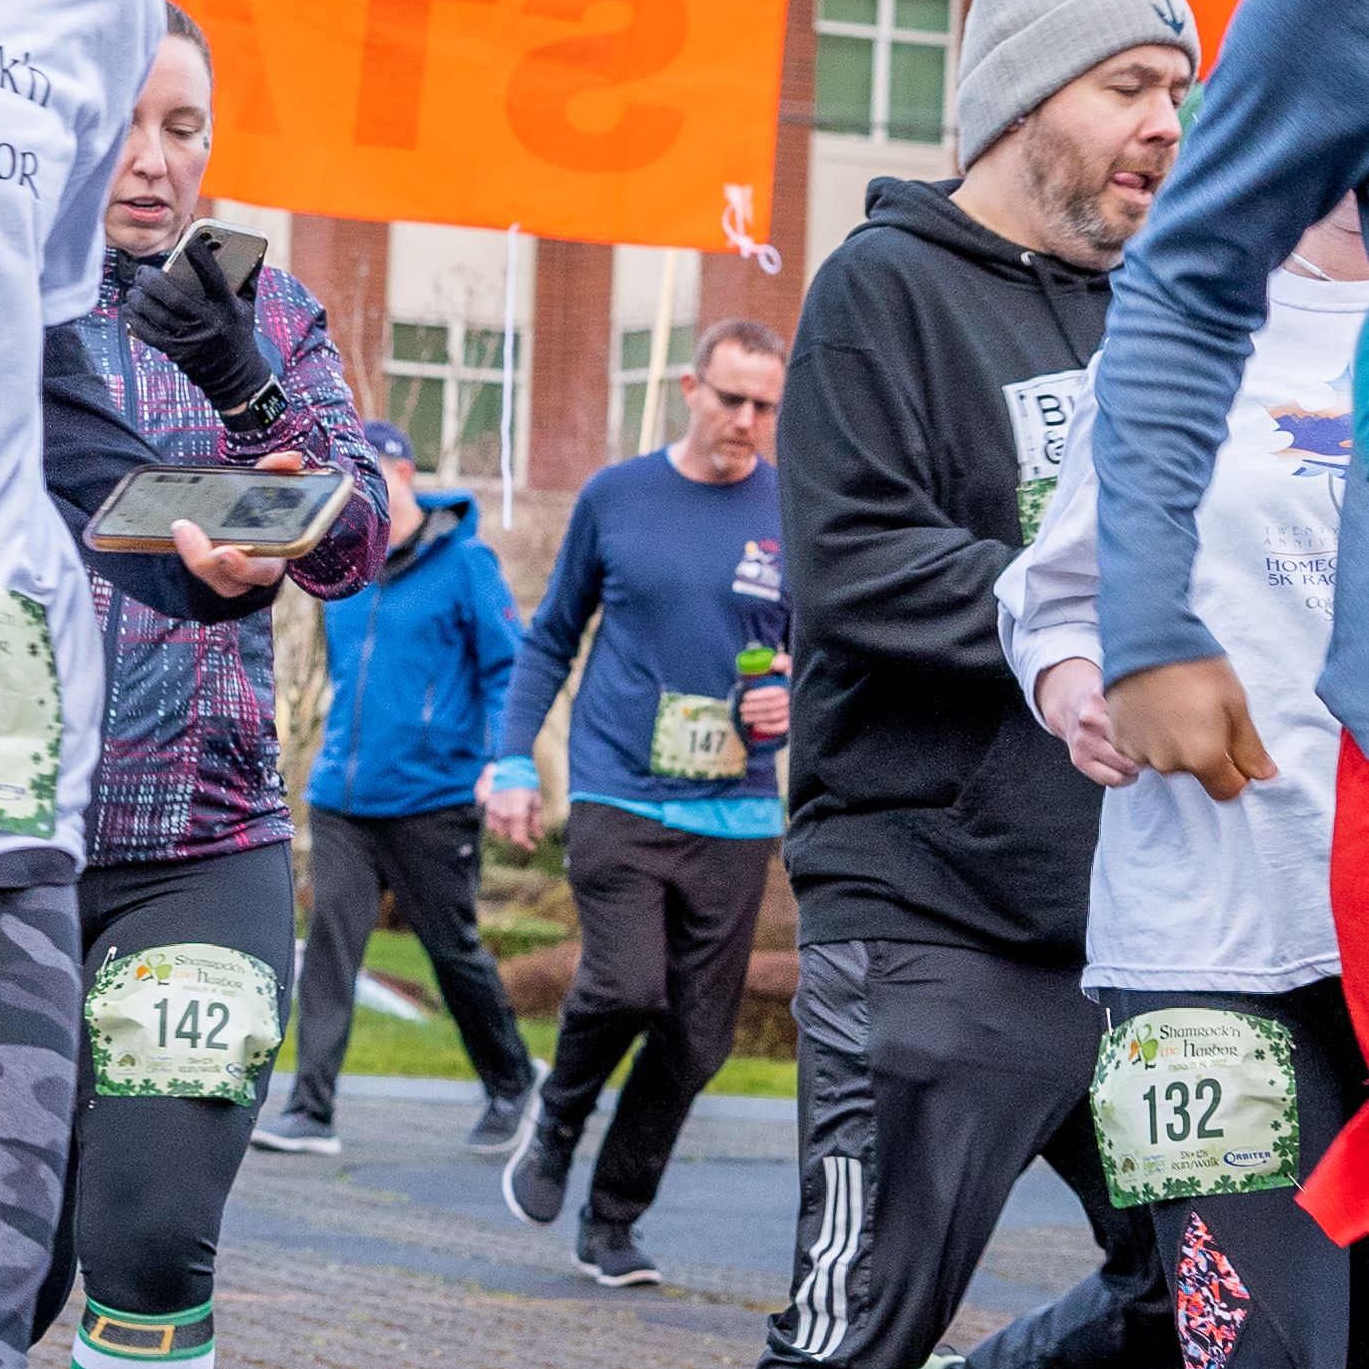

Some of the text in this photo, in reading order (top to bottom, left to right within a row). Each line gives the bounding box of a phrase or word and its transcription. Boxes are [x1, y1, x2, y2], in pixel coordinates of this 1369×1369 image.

[1269, 573, 1292, 586] 5K
[690, 731, 726, 753] 147
[154, 998, 230, 1050] 142
[1143, 1078, 1224, 1145] 132
